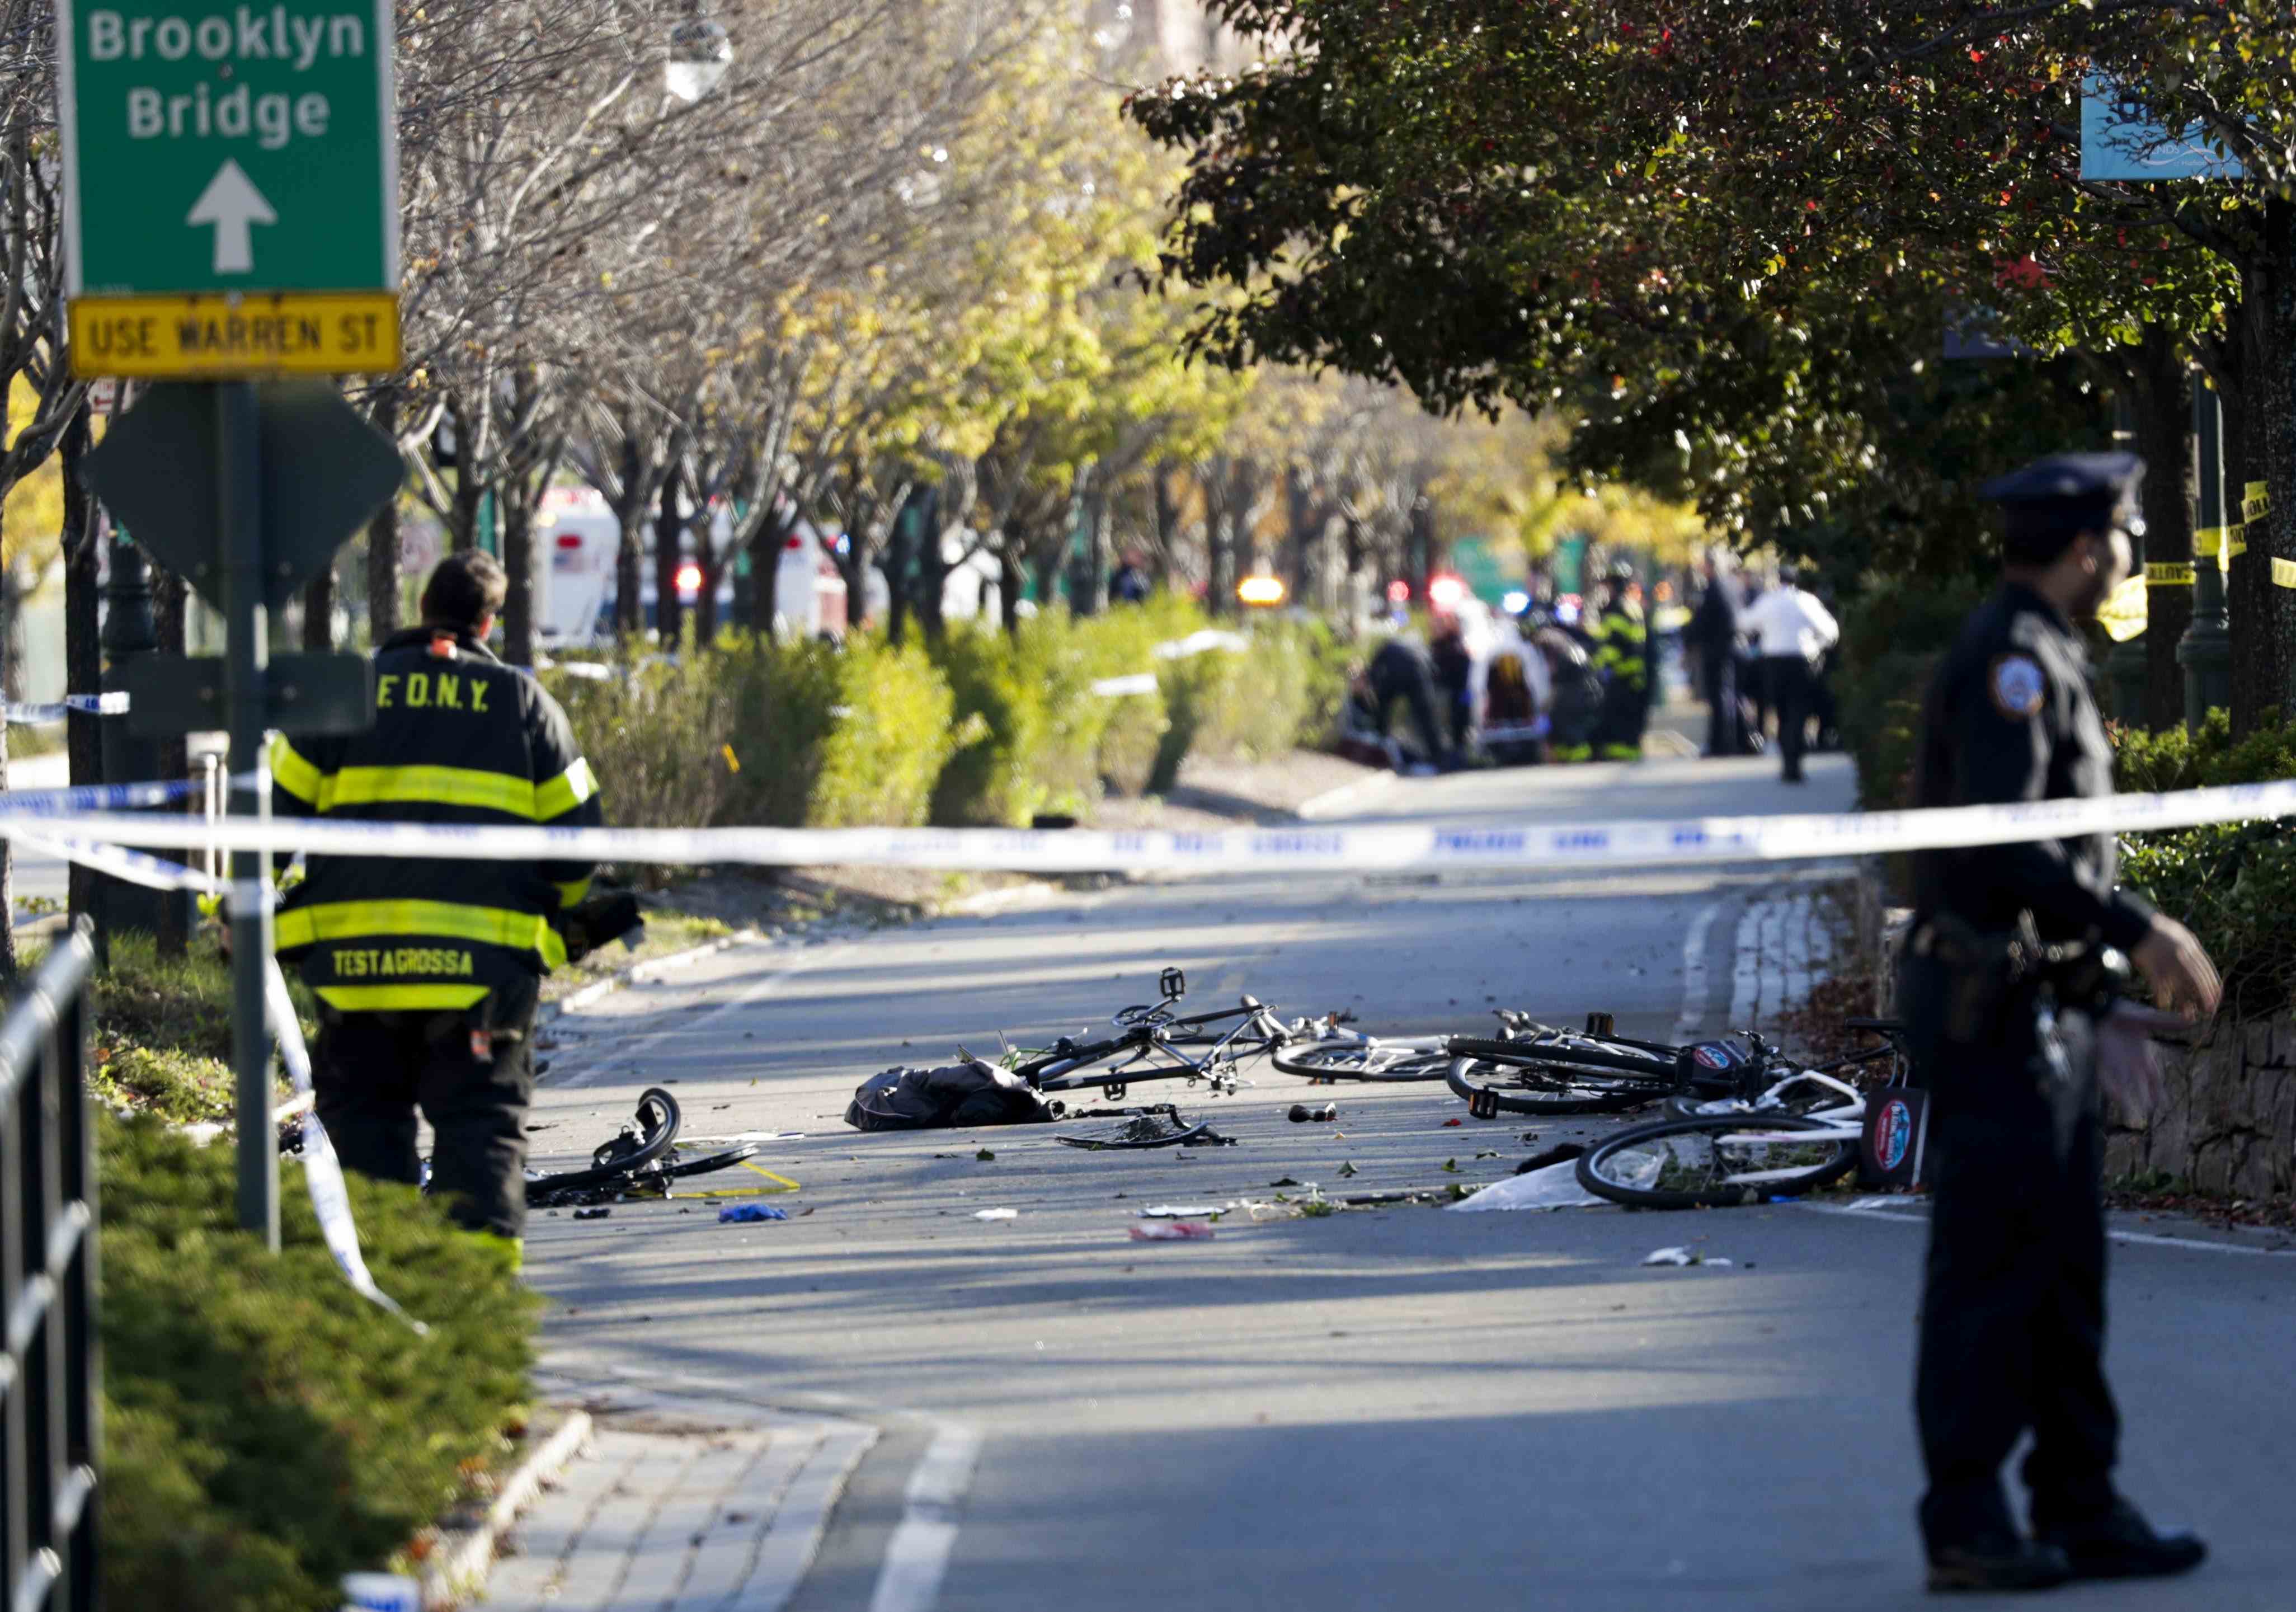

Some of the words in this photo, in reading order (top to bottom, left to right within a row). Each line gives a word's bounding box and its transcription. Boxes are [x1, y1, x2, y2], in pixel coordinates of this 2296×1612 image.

[88, 6, 364, 71] Brooklyn
[127, 82, 332, 149] Bridge
[90, 317, 158, 356] USE
[176, 314, 321, 354] WARREN
[340, 314, 379, 351] ST
